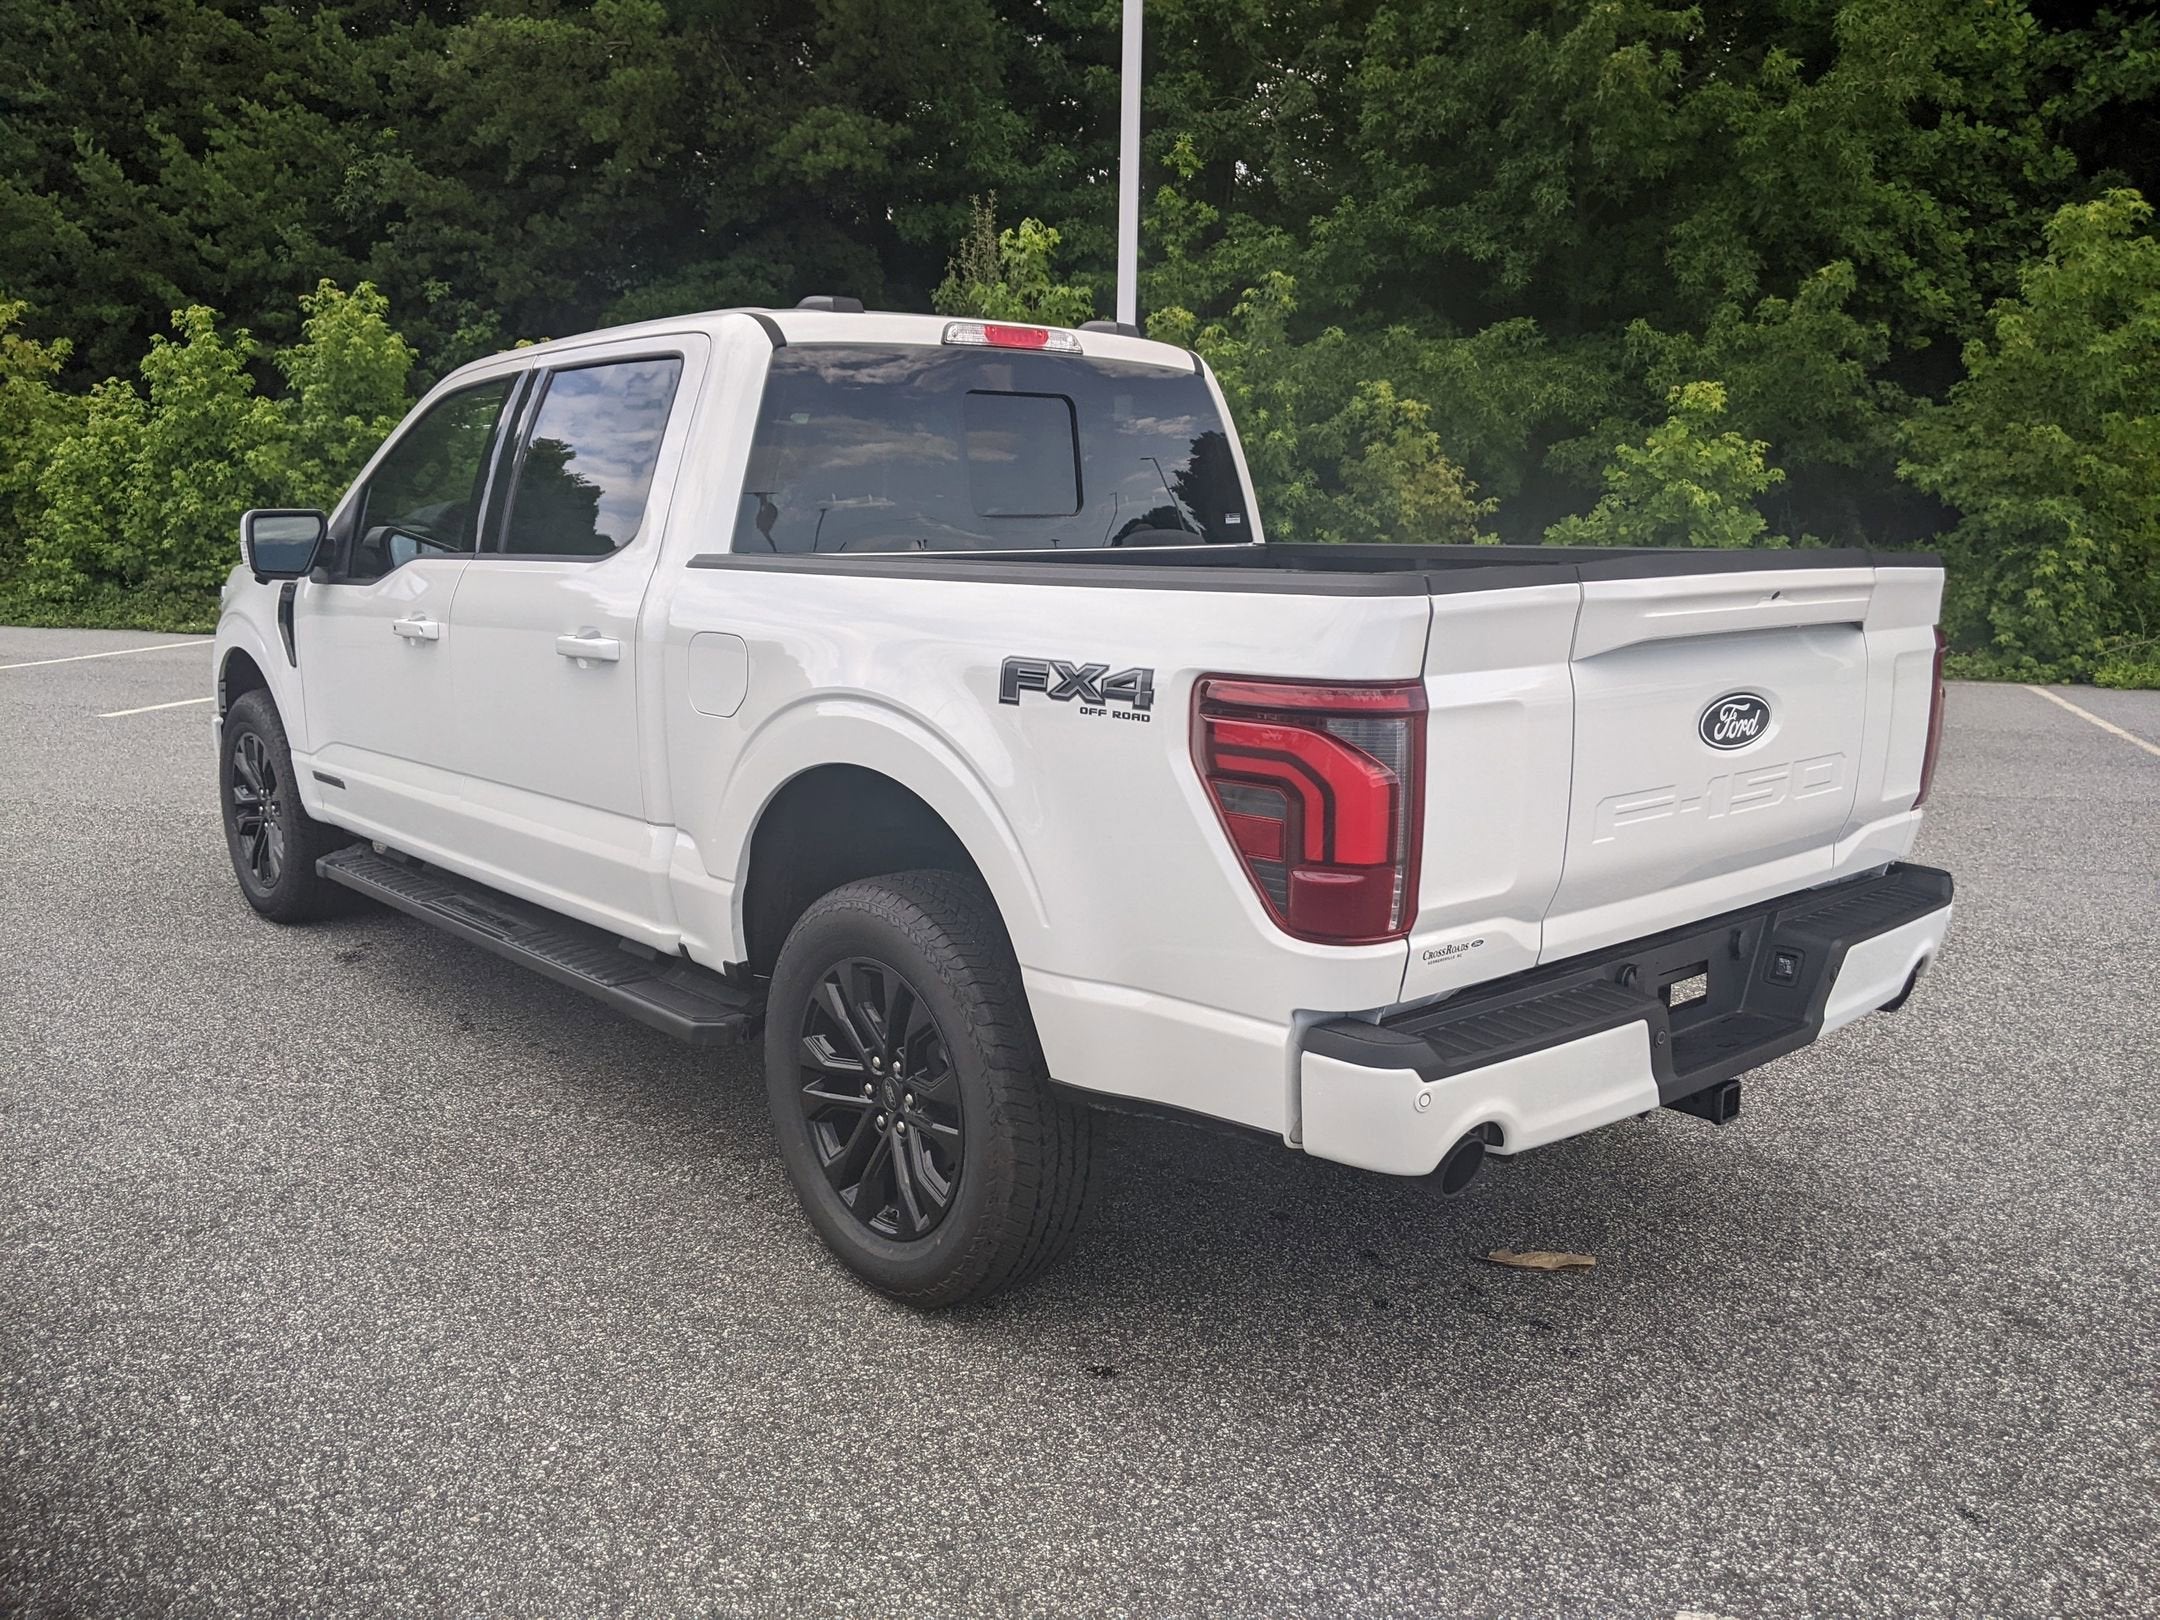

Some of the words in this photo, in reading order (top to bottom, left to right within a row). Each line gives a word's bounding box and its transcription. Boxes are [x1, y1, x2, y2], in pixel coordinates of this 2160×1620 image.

[998, 655, 1155, 712] FX4
[1079, 706, 1107, 717] OFF
[1112, 710, 1151, 723] ROAD
[1713, 702, 1761, 741] Ford
[1592, 752, 1847, 845] F-150
